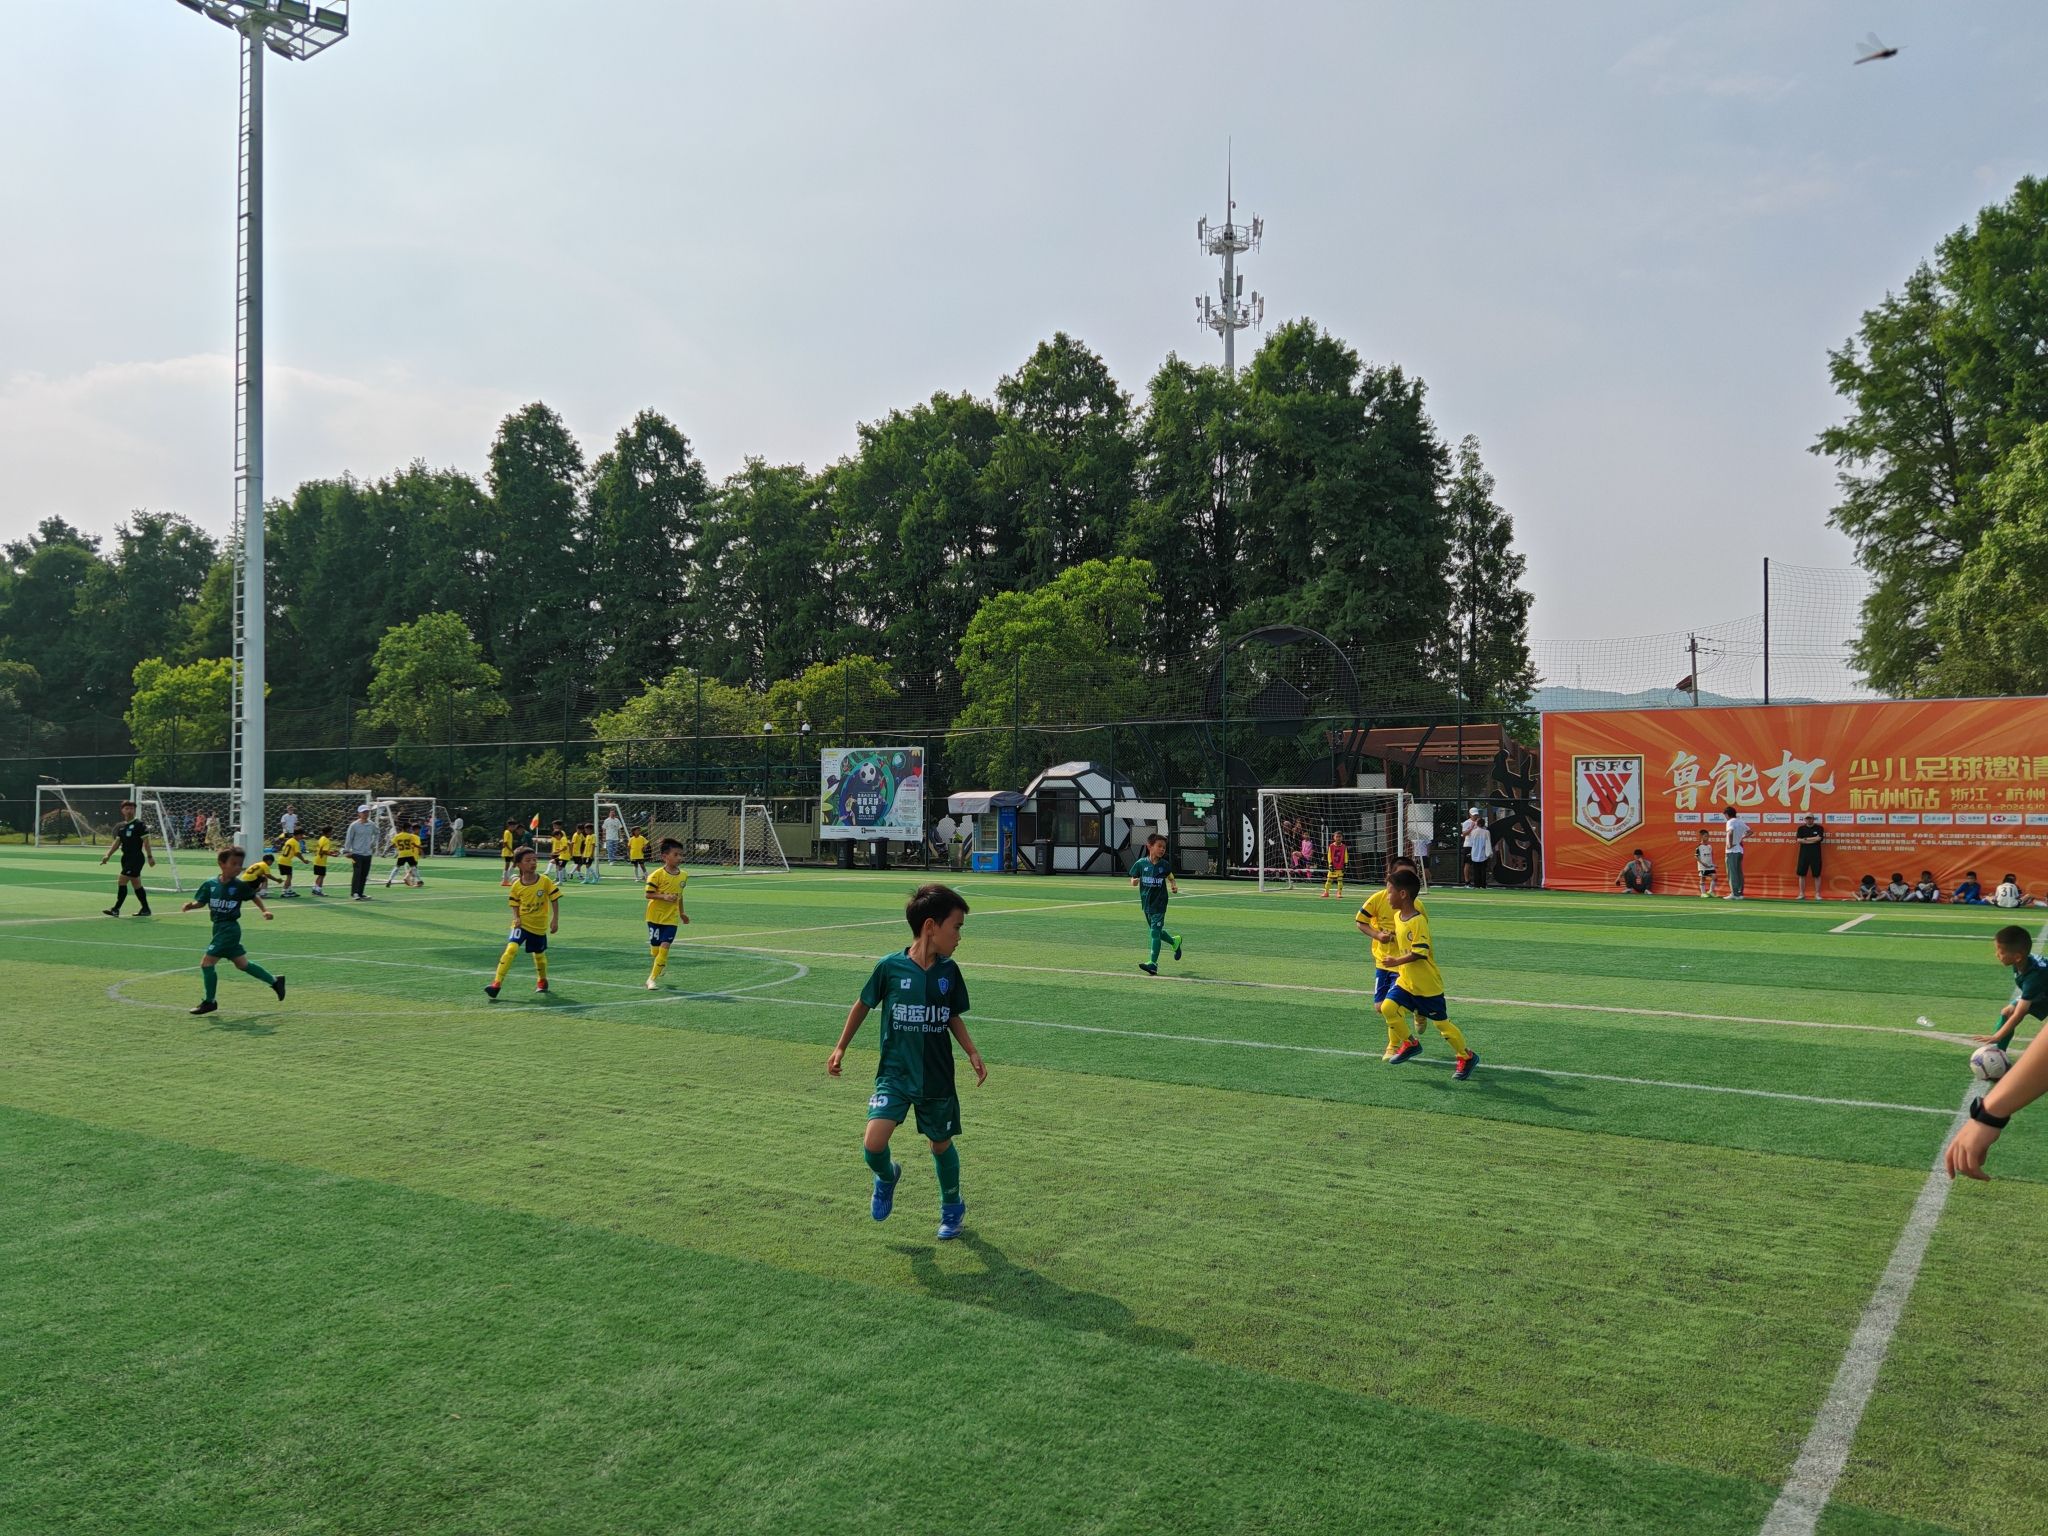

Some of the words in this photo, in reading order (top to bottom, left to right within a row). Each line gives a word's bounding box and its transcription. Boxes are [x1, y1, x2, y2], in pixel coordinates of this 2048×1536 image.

[1581, 760, 1633, 771] TSFC
[1662, 749, 1835, 812] 鲁能杯
[1849, 787, 1940, 810] 杭州站
[2001, 886, 2012, 898] 31
[893, 1021, 919, 1033] Green
